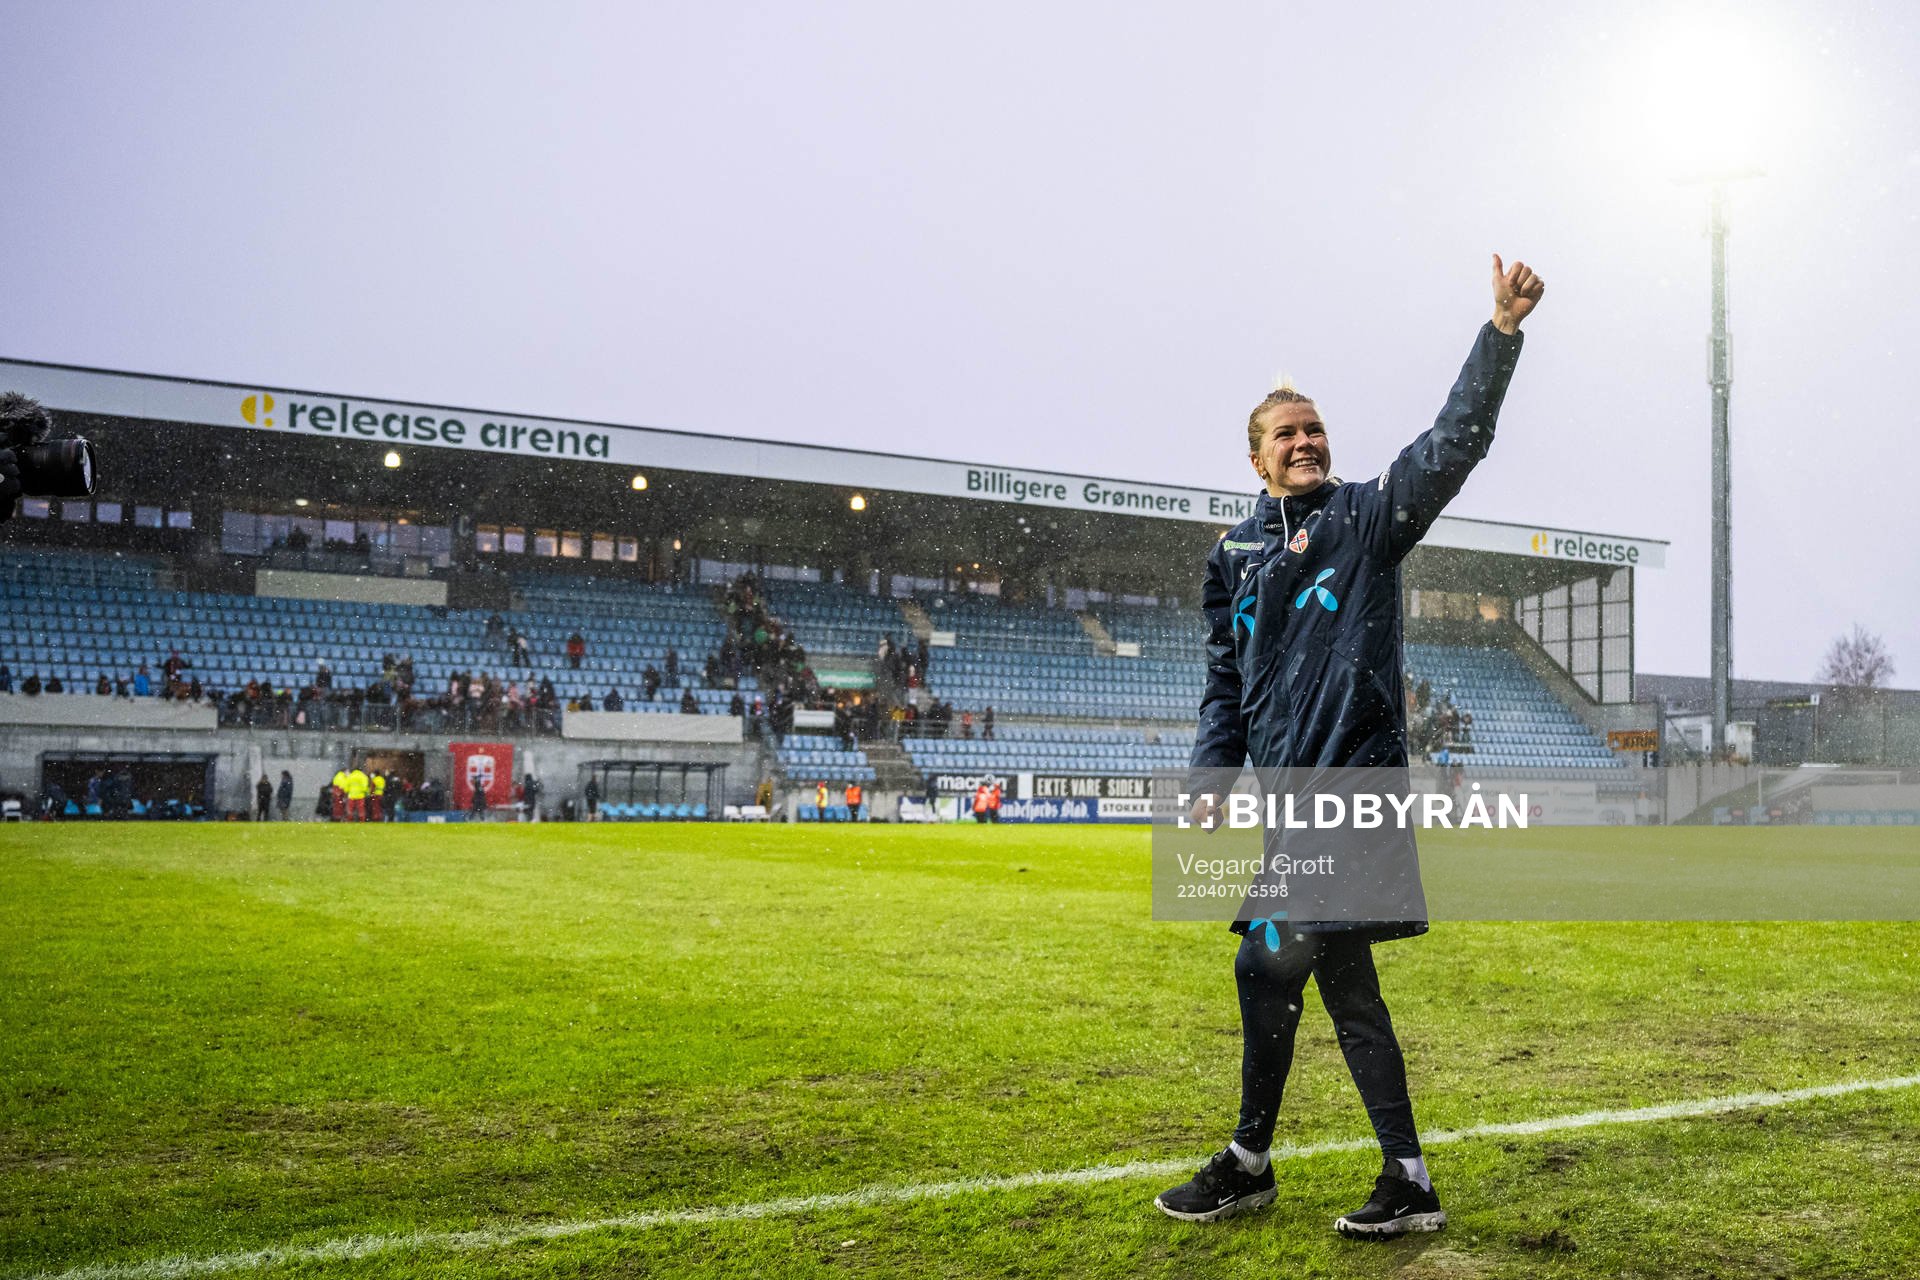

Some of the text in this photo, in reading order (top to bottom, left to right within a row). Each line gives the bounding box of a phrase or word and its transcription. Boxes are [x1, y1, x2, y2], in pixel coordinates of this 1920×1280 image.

[288, 401, 610, 458] release arena
[967, 470, 1067, 501] Billigere
[1083, 482, 1191, 514] Grønnere
[1554, 536, 1640, 564] release
[1037, 777, 1068, 796] EKTE
[1071, 777, 1102, 797] VARE
[1107, 778, 1145, 797] SIDEN
